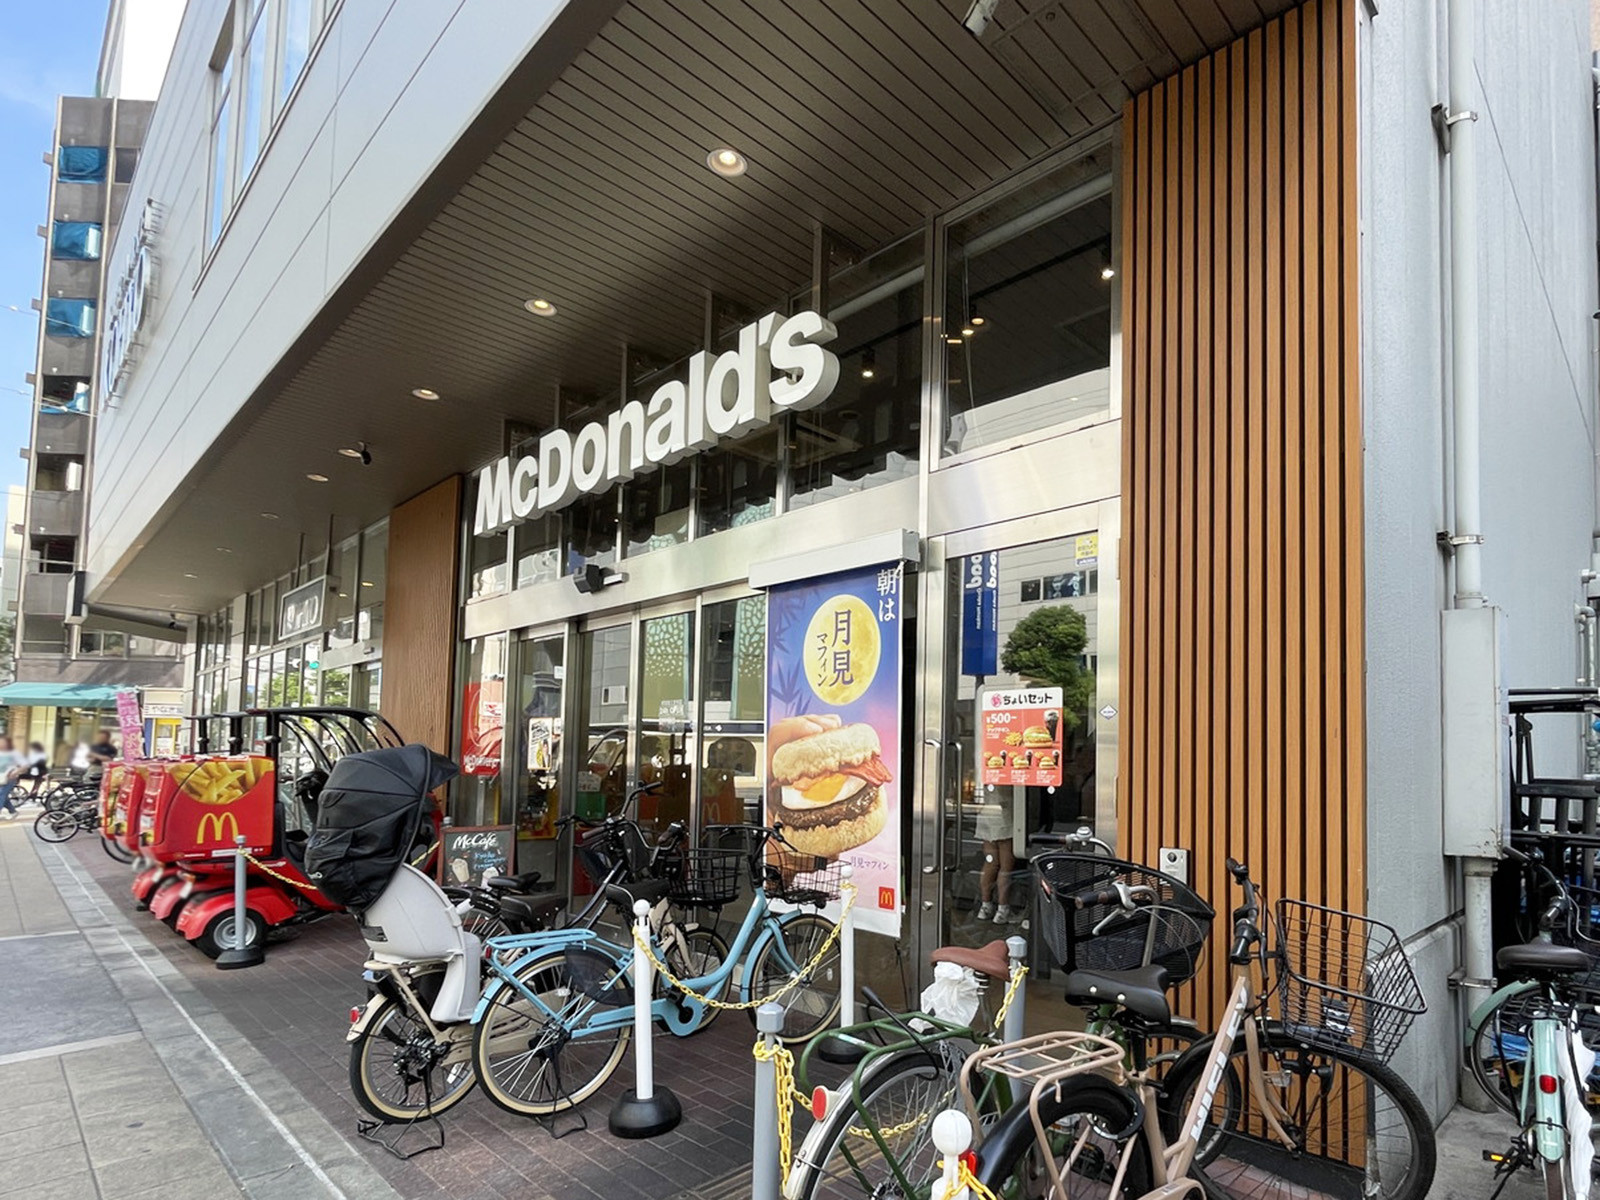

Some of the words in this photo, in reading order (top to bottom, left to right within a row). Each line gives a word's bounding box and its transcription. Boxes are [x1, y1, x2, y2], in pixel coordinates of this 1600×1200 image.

[474, 311, 838, 537] McDonald's
[876, 568, 896, 622] 朝は
[816, 632, 829, 687] マフィン
[830, 609, 854, 687] 月見
[1002, 692, 1053, 706] ちょいセット
